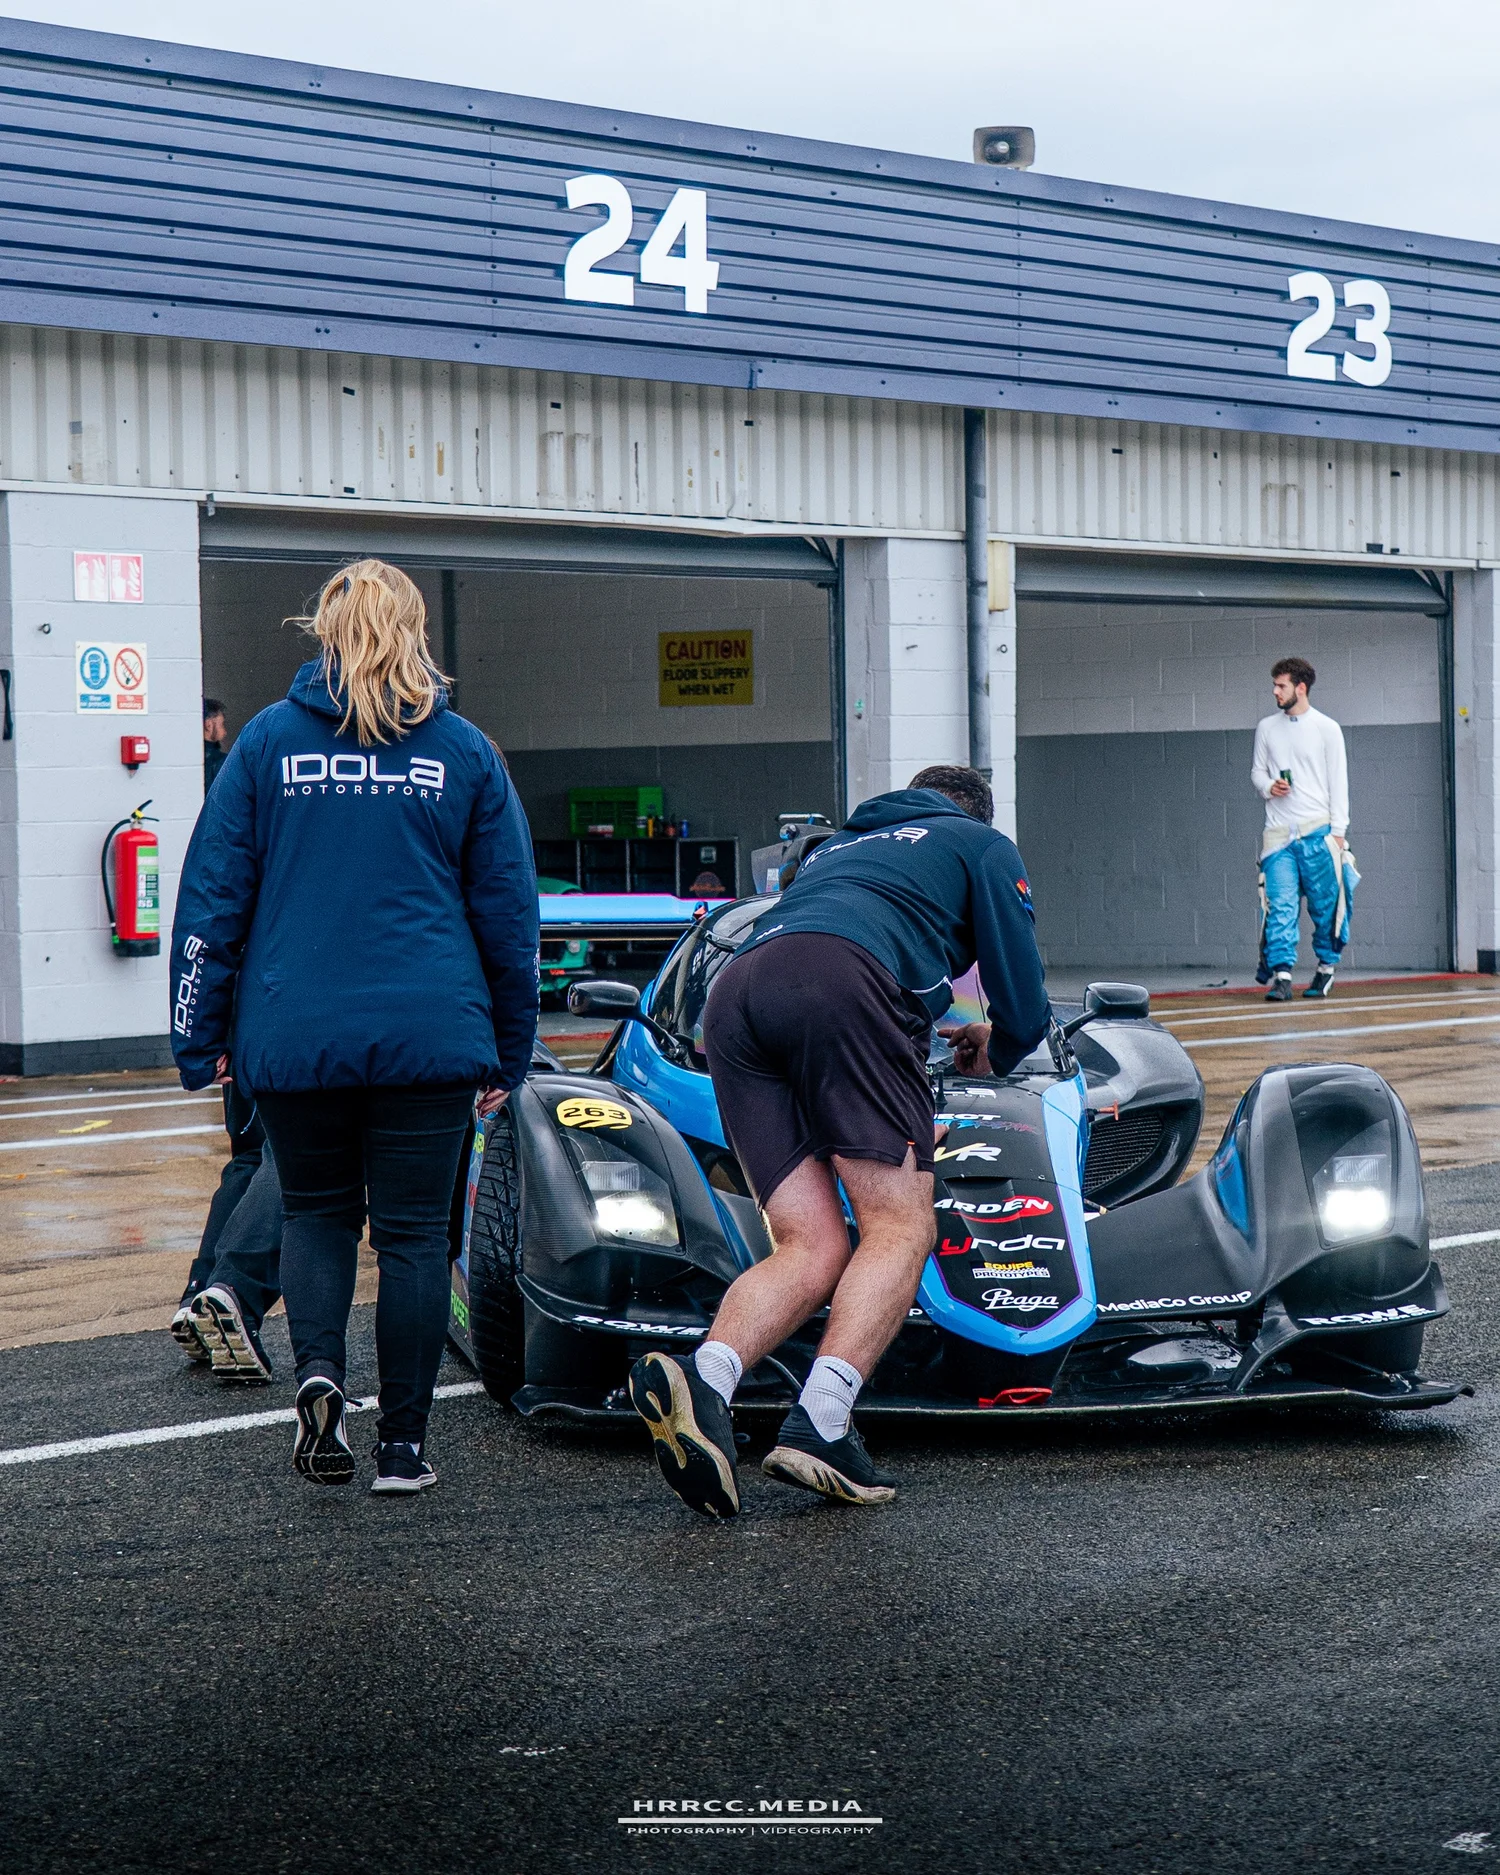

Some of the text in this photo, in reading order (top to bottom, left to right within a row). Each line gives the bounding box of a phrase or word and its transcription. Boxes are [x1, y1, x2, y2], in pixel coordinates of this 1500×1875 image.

[564, 174, 720, 314] 24
[1287, 271, 1392, 387] 23
[665, 640, 747, 661] CAUTION
[663, 667, 750, 682] FLOOR SLIPPERY
[678, 683, 735, 695] WHEN WET
[284, 784, 443, 802] MOTORSPORT
[563, 1107, 627, 1120] 263
[933, 1198, 1050, 1214] ARDEN
[974, 1270, 1050, 1278] PROTOTYPES
[981, 1288, 1060, 1312] Praga
[1096, 1290, 1252, 1313] MediaCo Group
[1298, 1304, 1427, 1325] ROWE
